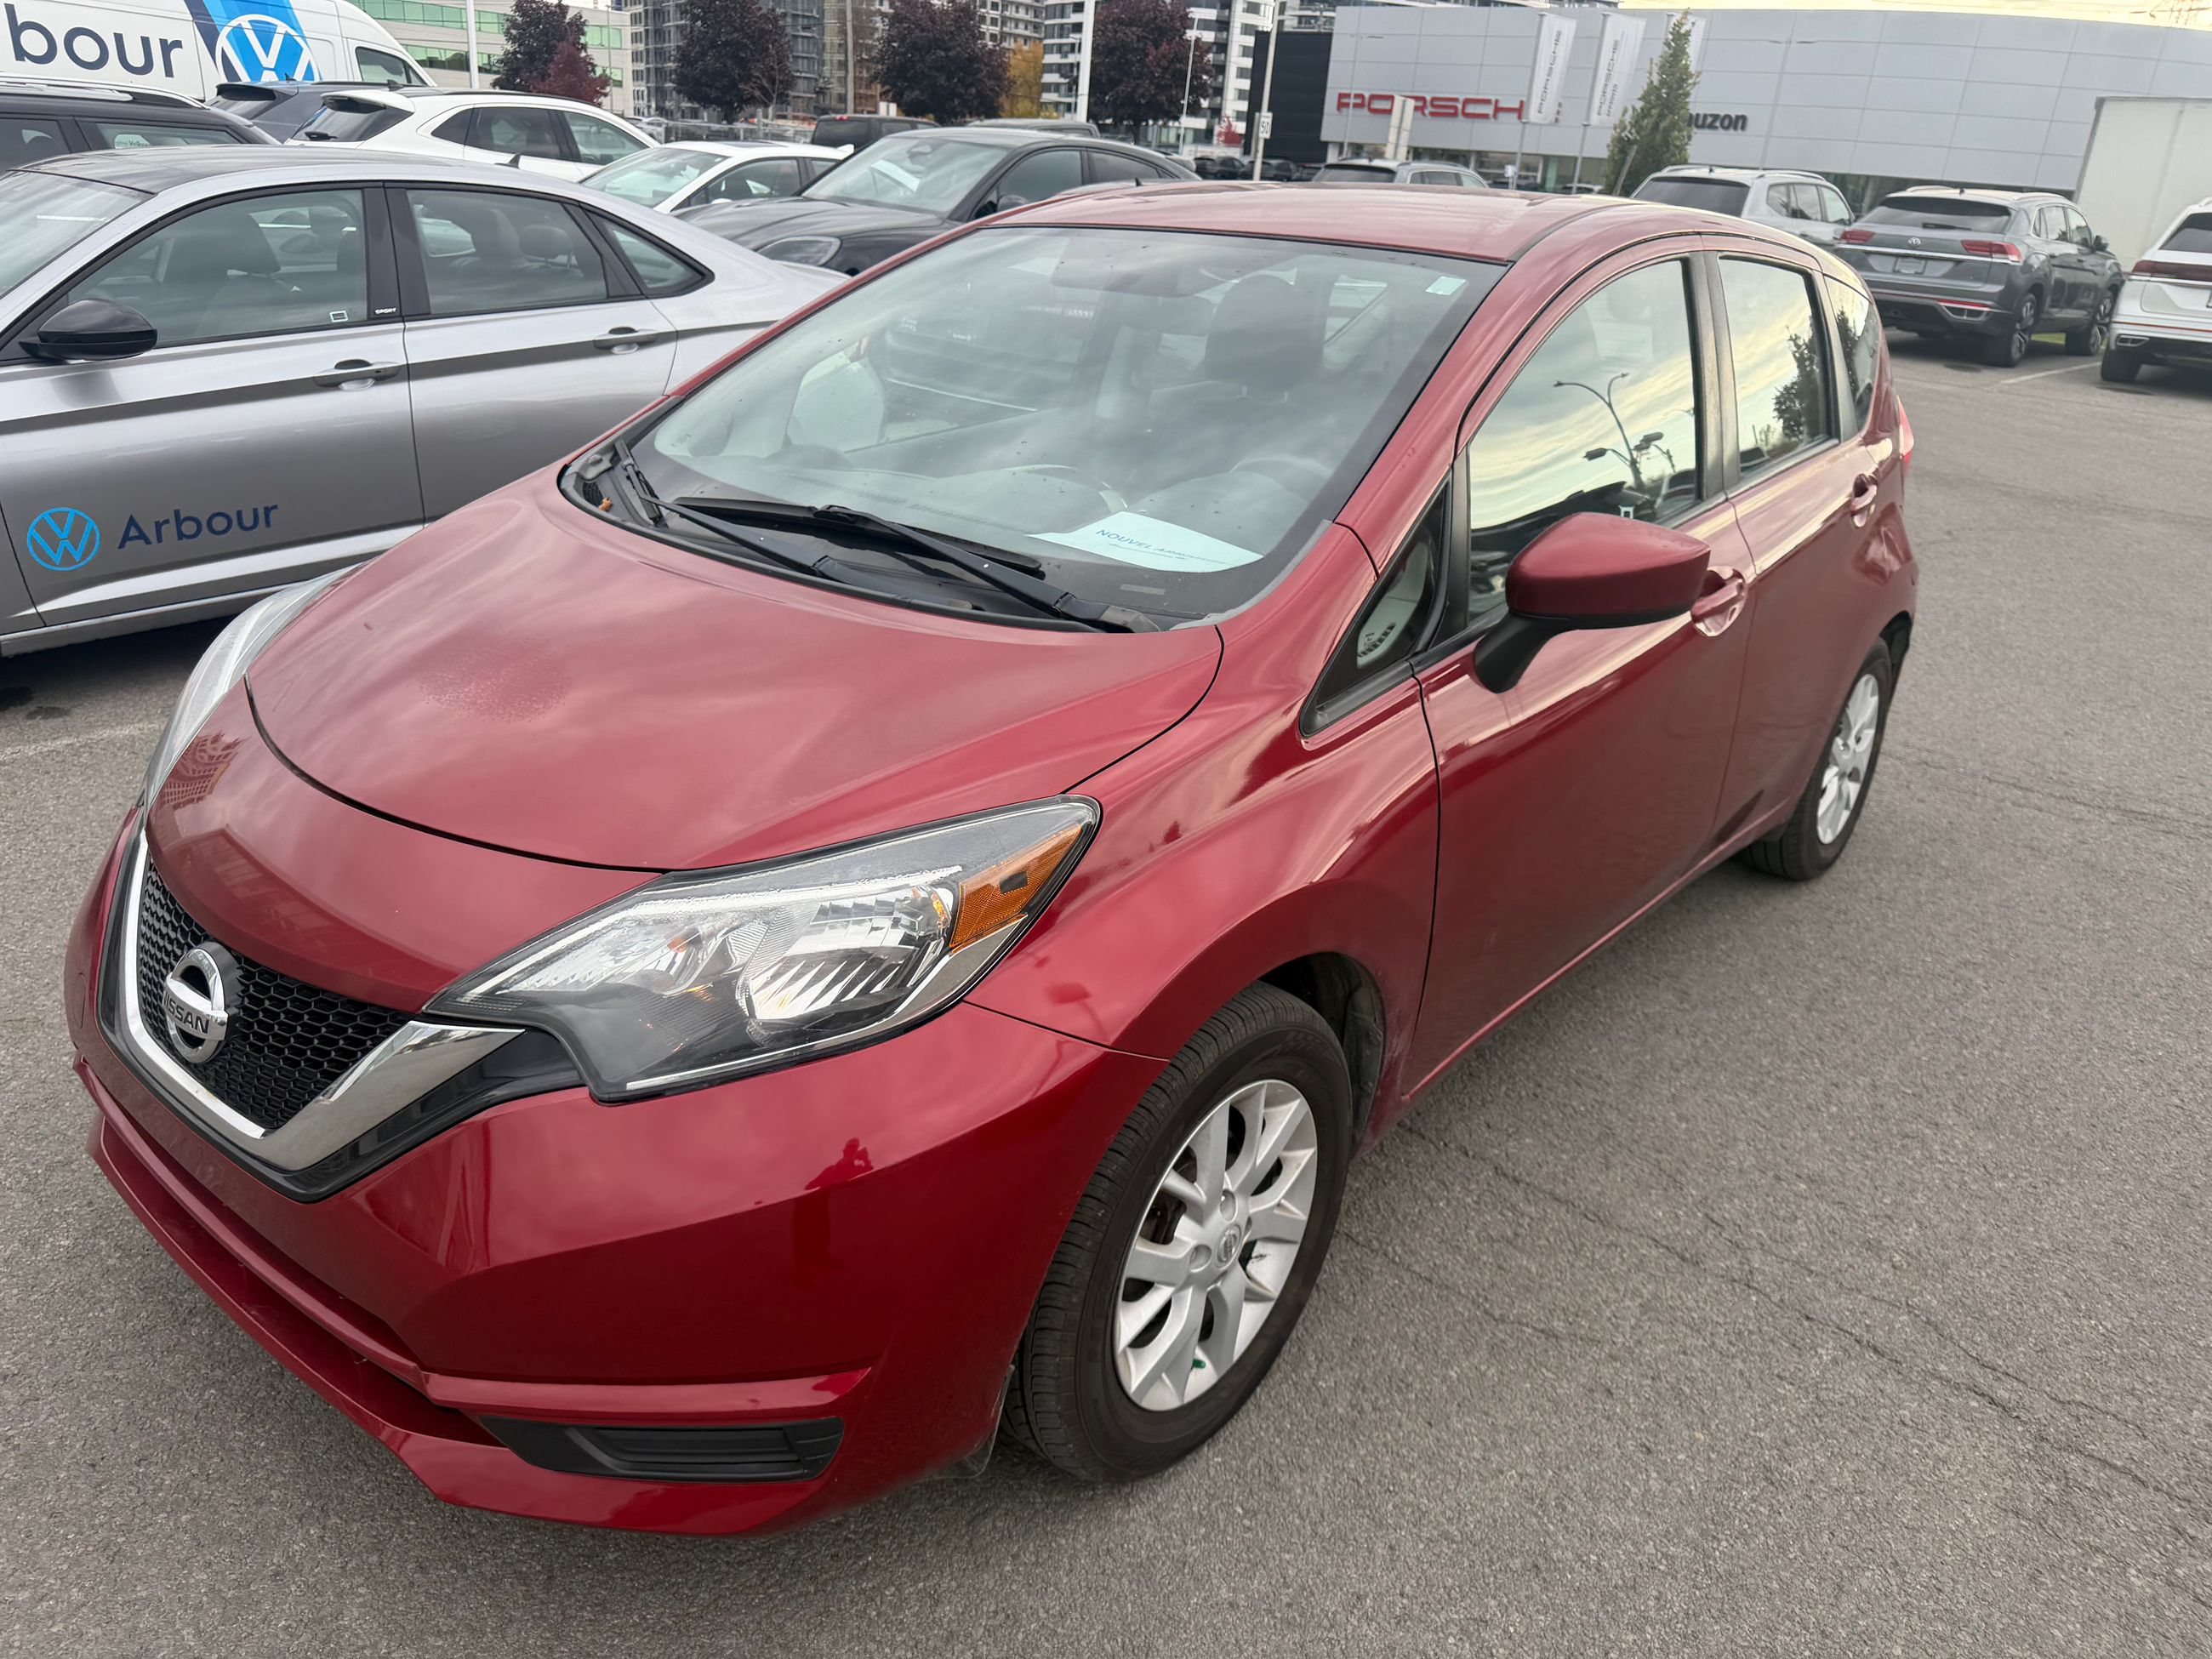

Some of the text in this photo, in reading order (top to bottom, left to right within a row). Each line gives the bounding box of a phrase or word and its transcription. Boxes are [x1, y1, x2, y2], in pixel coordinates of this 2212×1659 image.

[1537, 30, 1562, 114] PORSCHE
[1337, 92, 1562, 123] PORSCH
[117, 505, 279, 550] Arbour
[162, 989, 210, 1035] NISSAN
